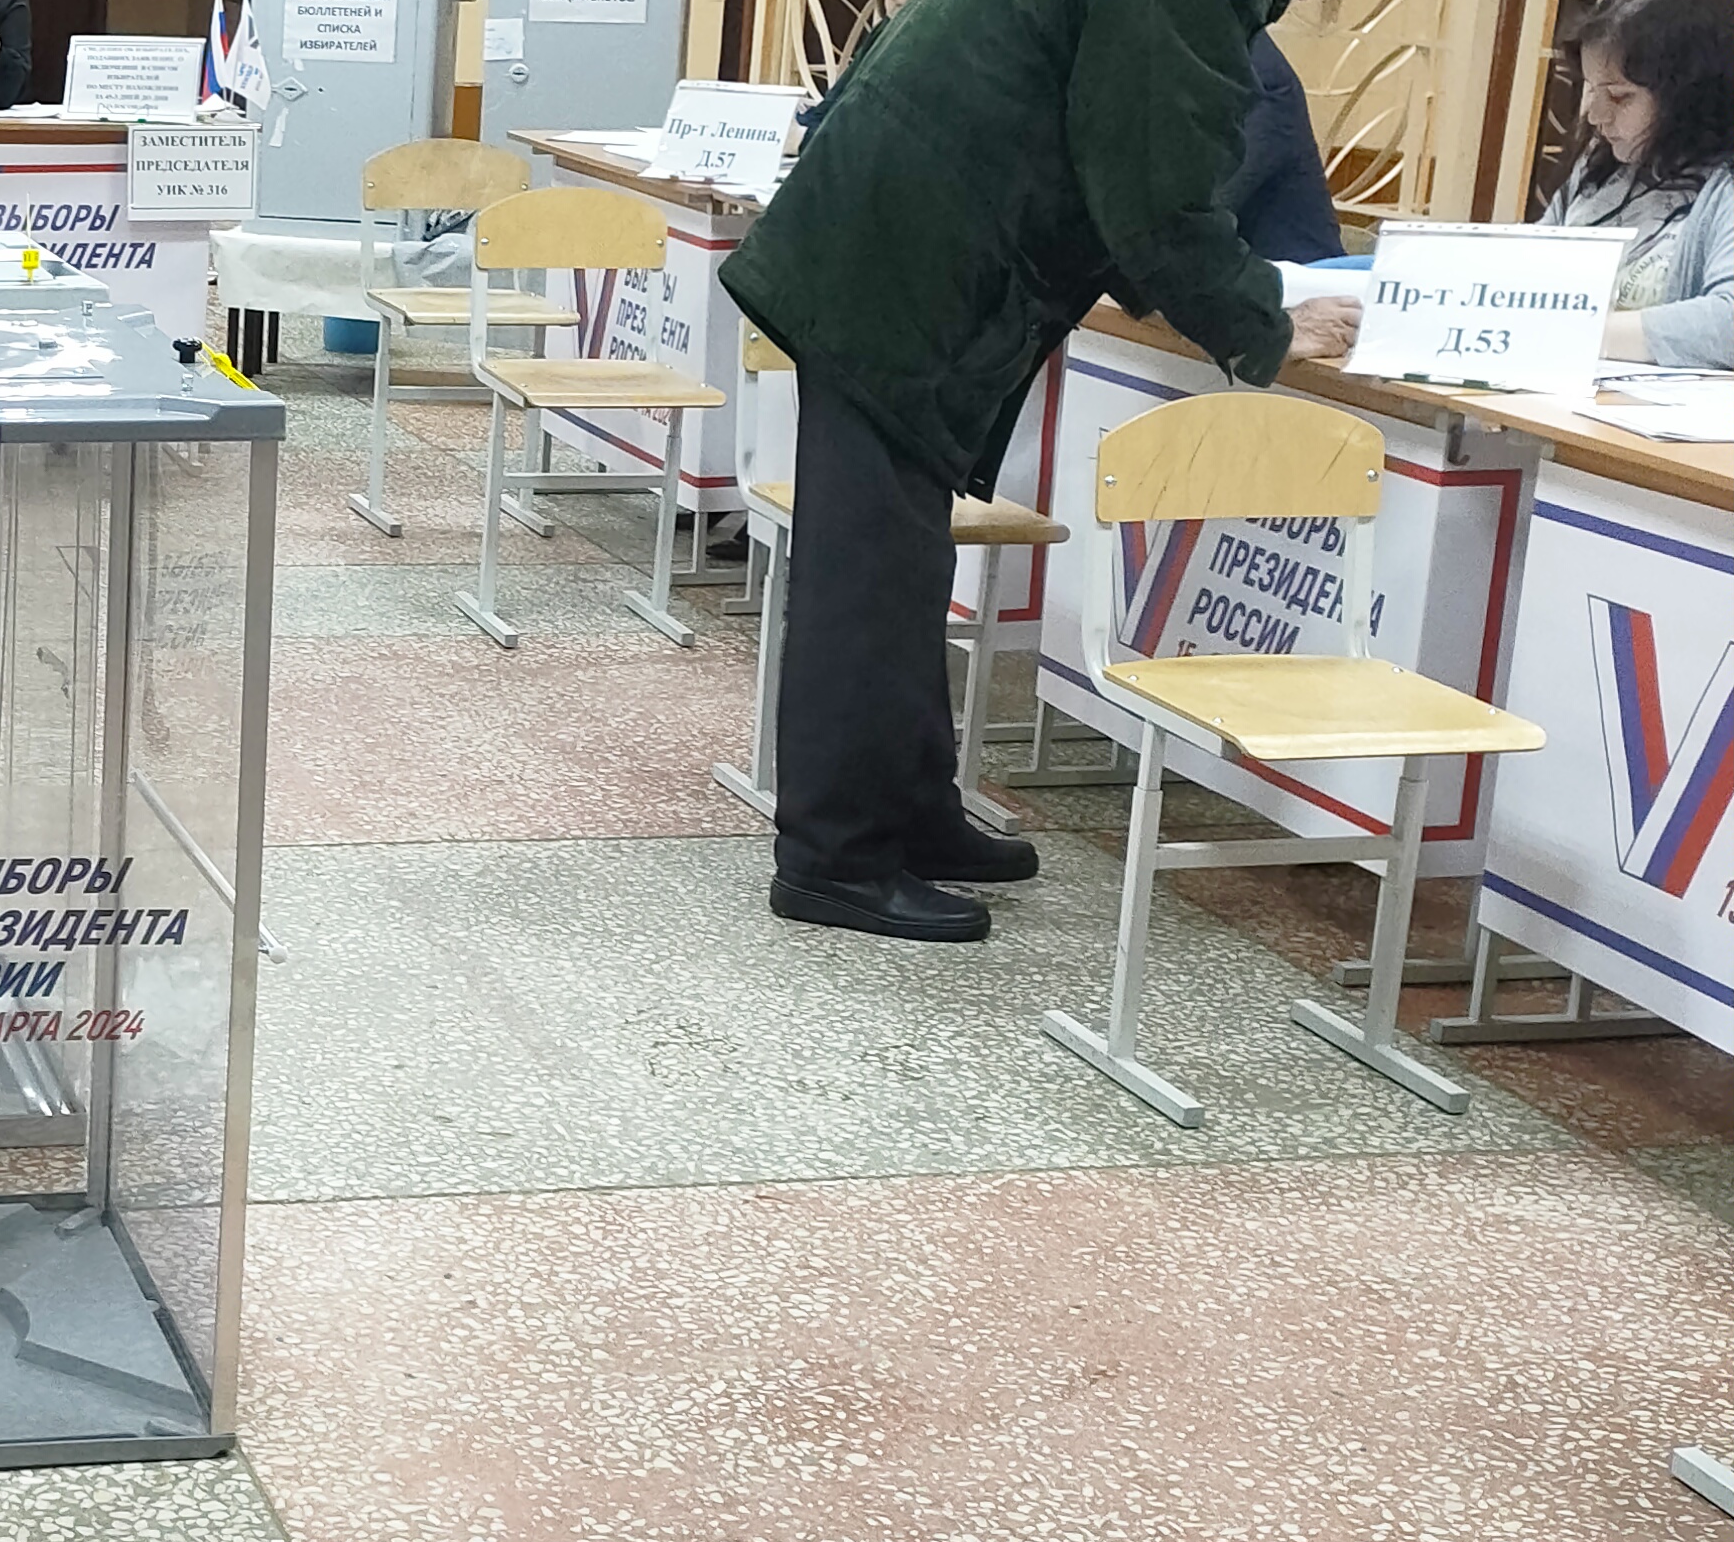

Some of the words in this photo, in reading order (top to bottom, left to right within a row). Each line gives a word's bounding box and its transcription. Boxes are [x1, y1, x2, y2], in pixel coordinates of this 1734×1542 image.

[297, 3, 371, 18] БЮЛЛЕТЕНЕЙ
[374, 7, 383, 17] И
[317, 23, 361, 35] СПИСКА
[300, 37, 377, 52] ИЗБИРАТЕЛЕЙ
[139, 135, 247, 149] ЗАМЕСТИТЕЛЬ
[667, 118, 709, 142] Пр-т
[711, 121, 781, 146] Ленина,
[136, 158, 250, 173] ПРЕДСЕДАТЕЛЯ
[696, 150, 736, 170] Д.57
[156, 183, 186, 198] УИК
[189, 183, 204, 197] №
[207, 183, 228, 196] 316
[40, 242, 157, 270] ИДЕНТА
[624, 268, 677, 304] ВЫБЫ
[1375, 279, 1457, 313] Пр-т
[1461, 282, 1599, 316] Ленина,
[615, 298, 690, 354] ПРЕЗЕНТА
[1437, 328, 1512, 356] Д.53
[1209, 533, 1386, 637] ПРЕЗИДЕА
[1187, 588, 1301, 655] РОССИИ
[66, 1009, 144, 1042] 2024
